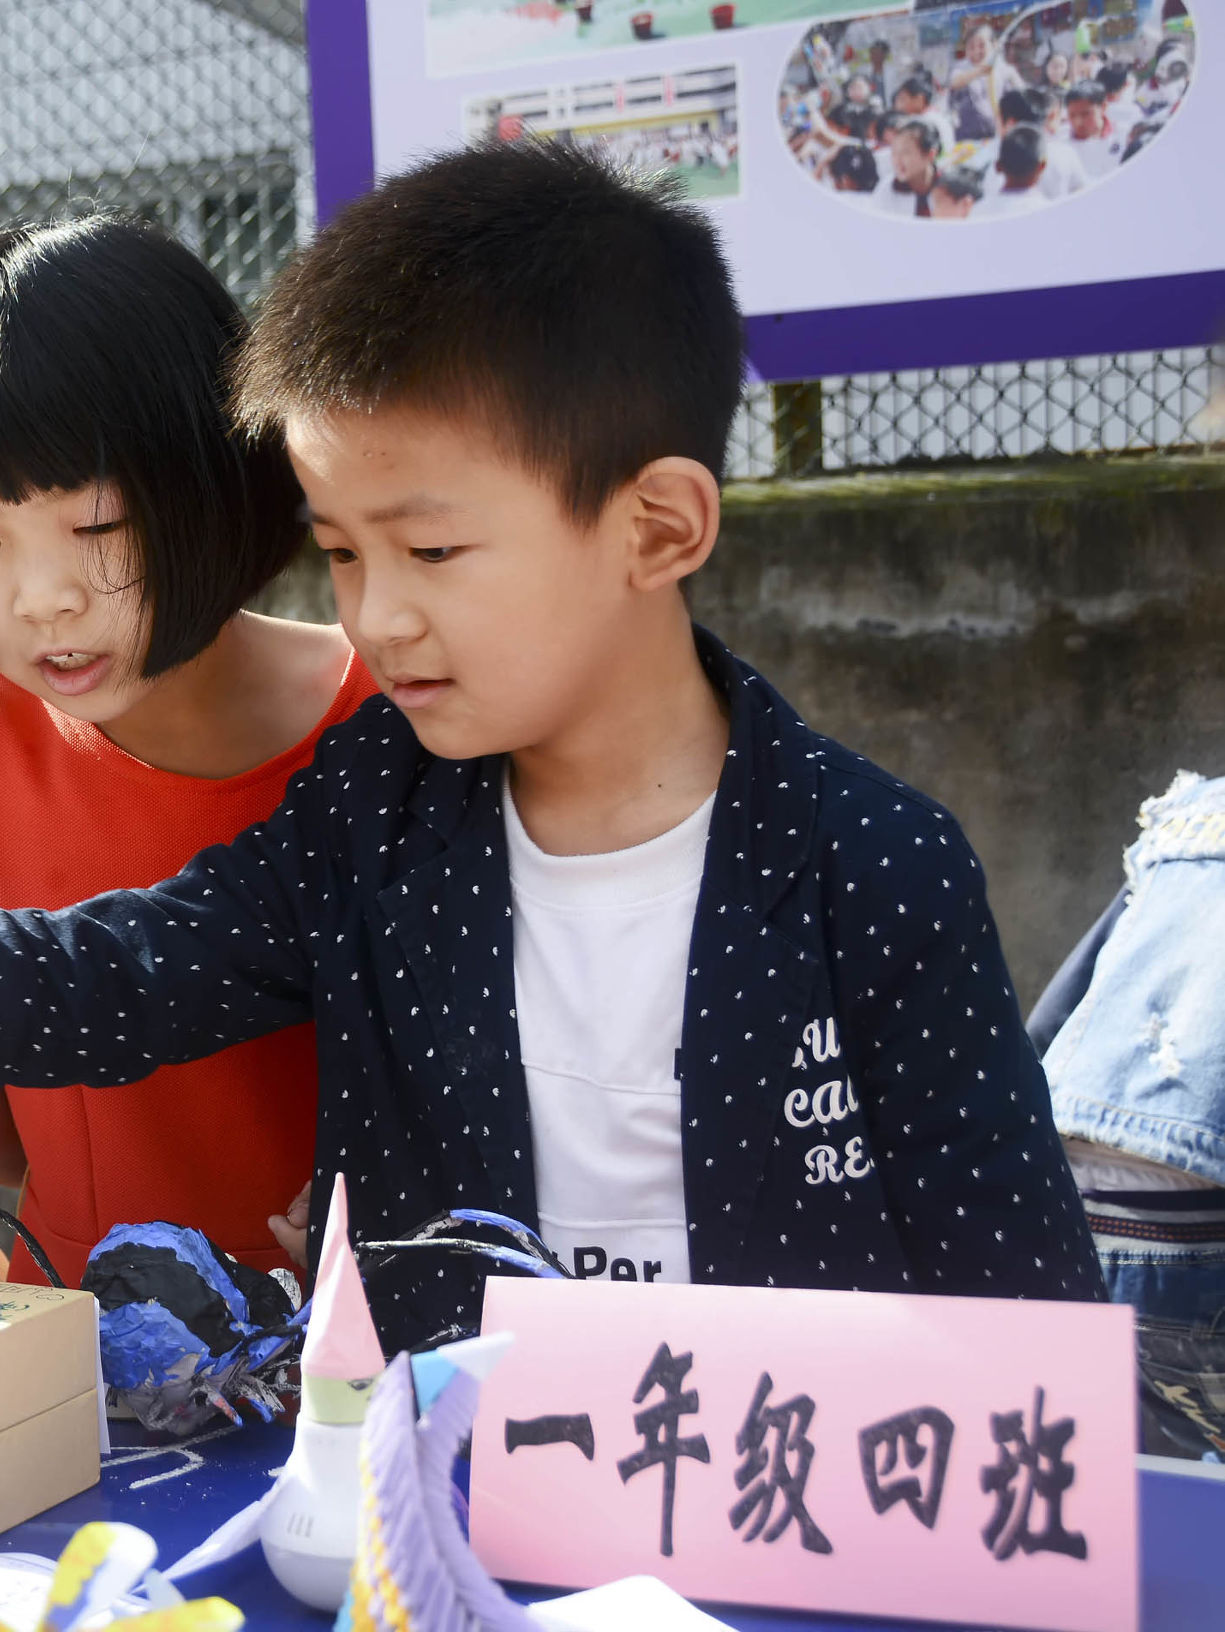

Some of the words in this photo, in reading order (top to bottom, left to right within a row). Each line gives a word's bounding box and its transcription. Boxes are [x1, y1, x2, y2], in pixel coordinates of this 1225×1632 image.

[504, 1341, 1089, 1562] 一年级四班
